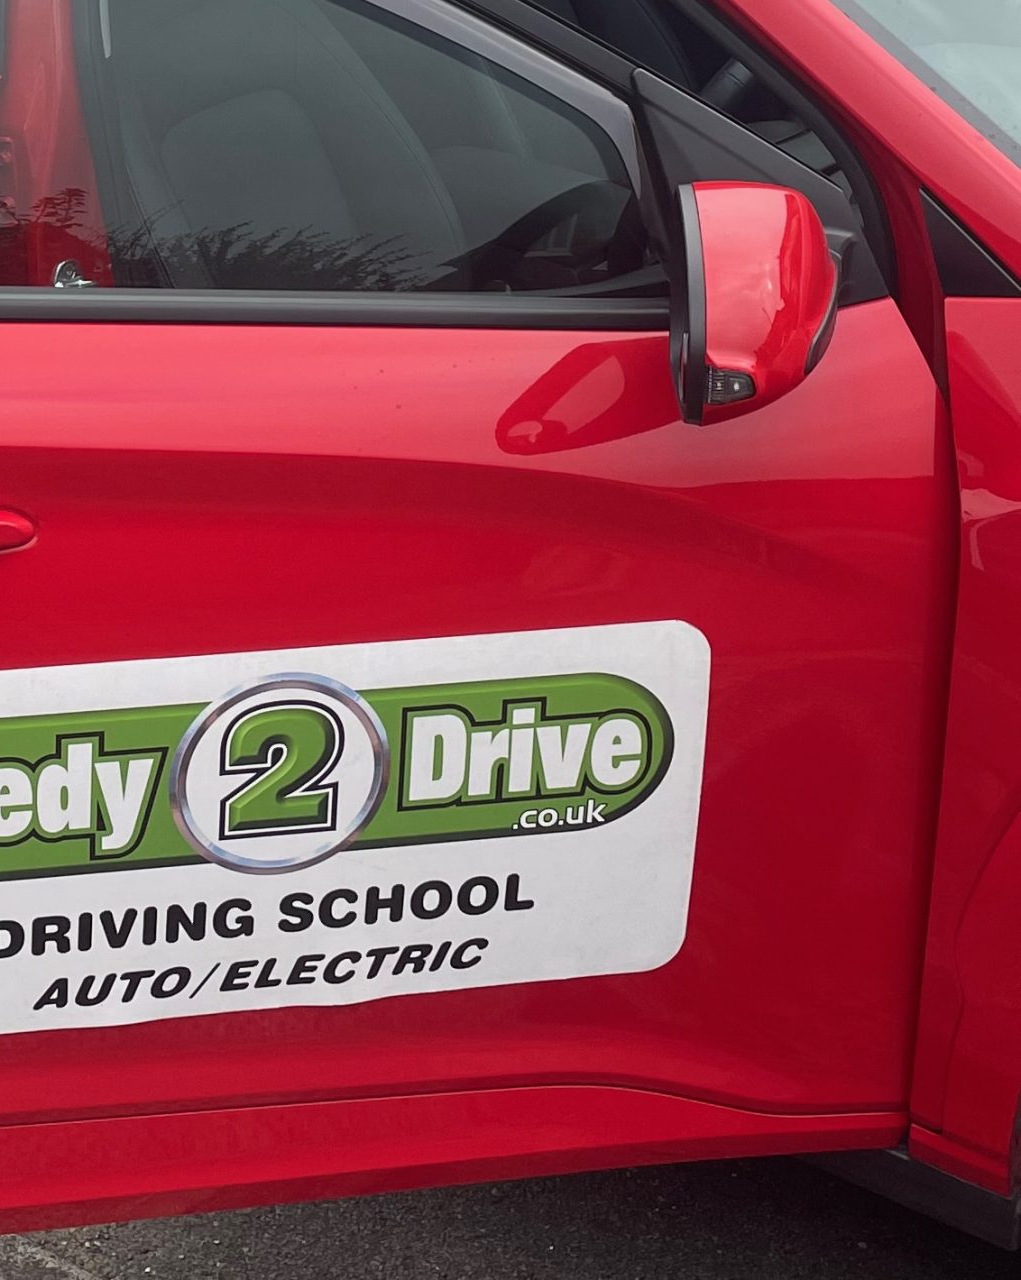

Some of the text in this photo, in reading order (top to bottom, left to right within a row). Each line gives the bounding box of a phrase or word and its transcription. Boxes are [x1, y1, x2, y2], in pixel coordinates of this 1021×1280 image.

[220, 700, 344, 840] 2
[407, 706, 643, 802] Drive
[511, 798, 608, 830] .co.uk
[278, 873, 535, 933] SCHOOL
[32, 937, 489, 1010] AUTO/ELECTRIC
